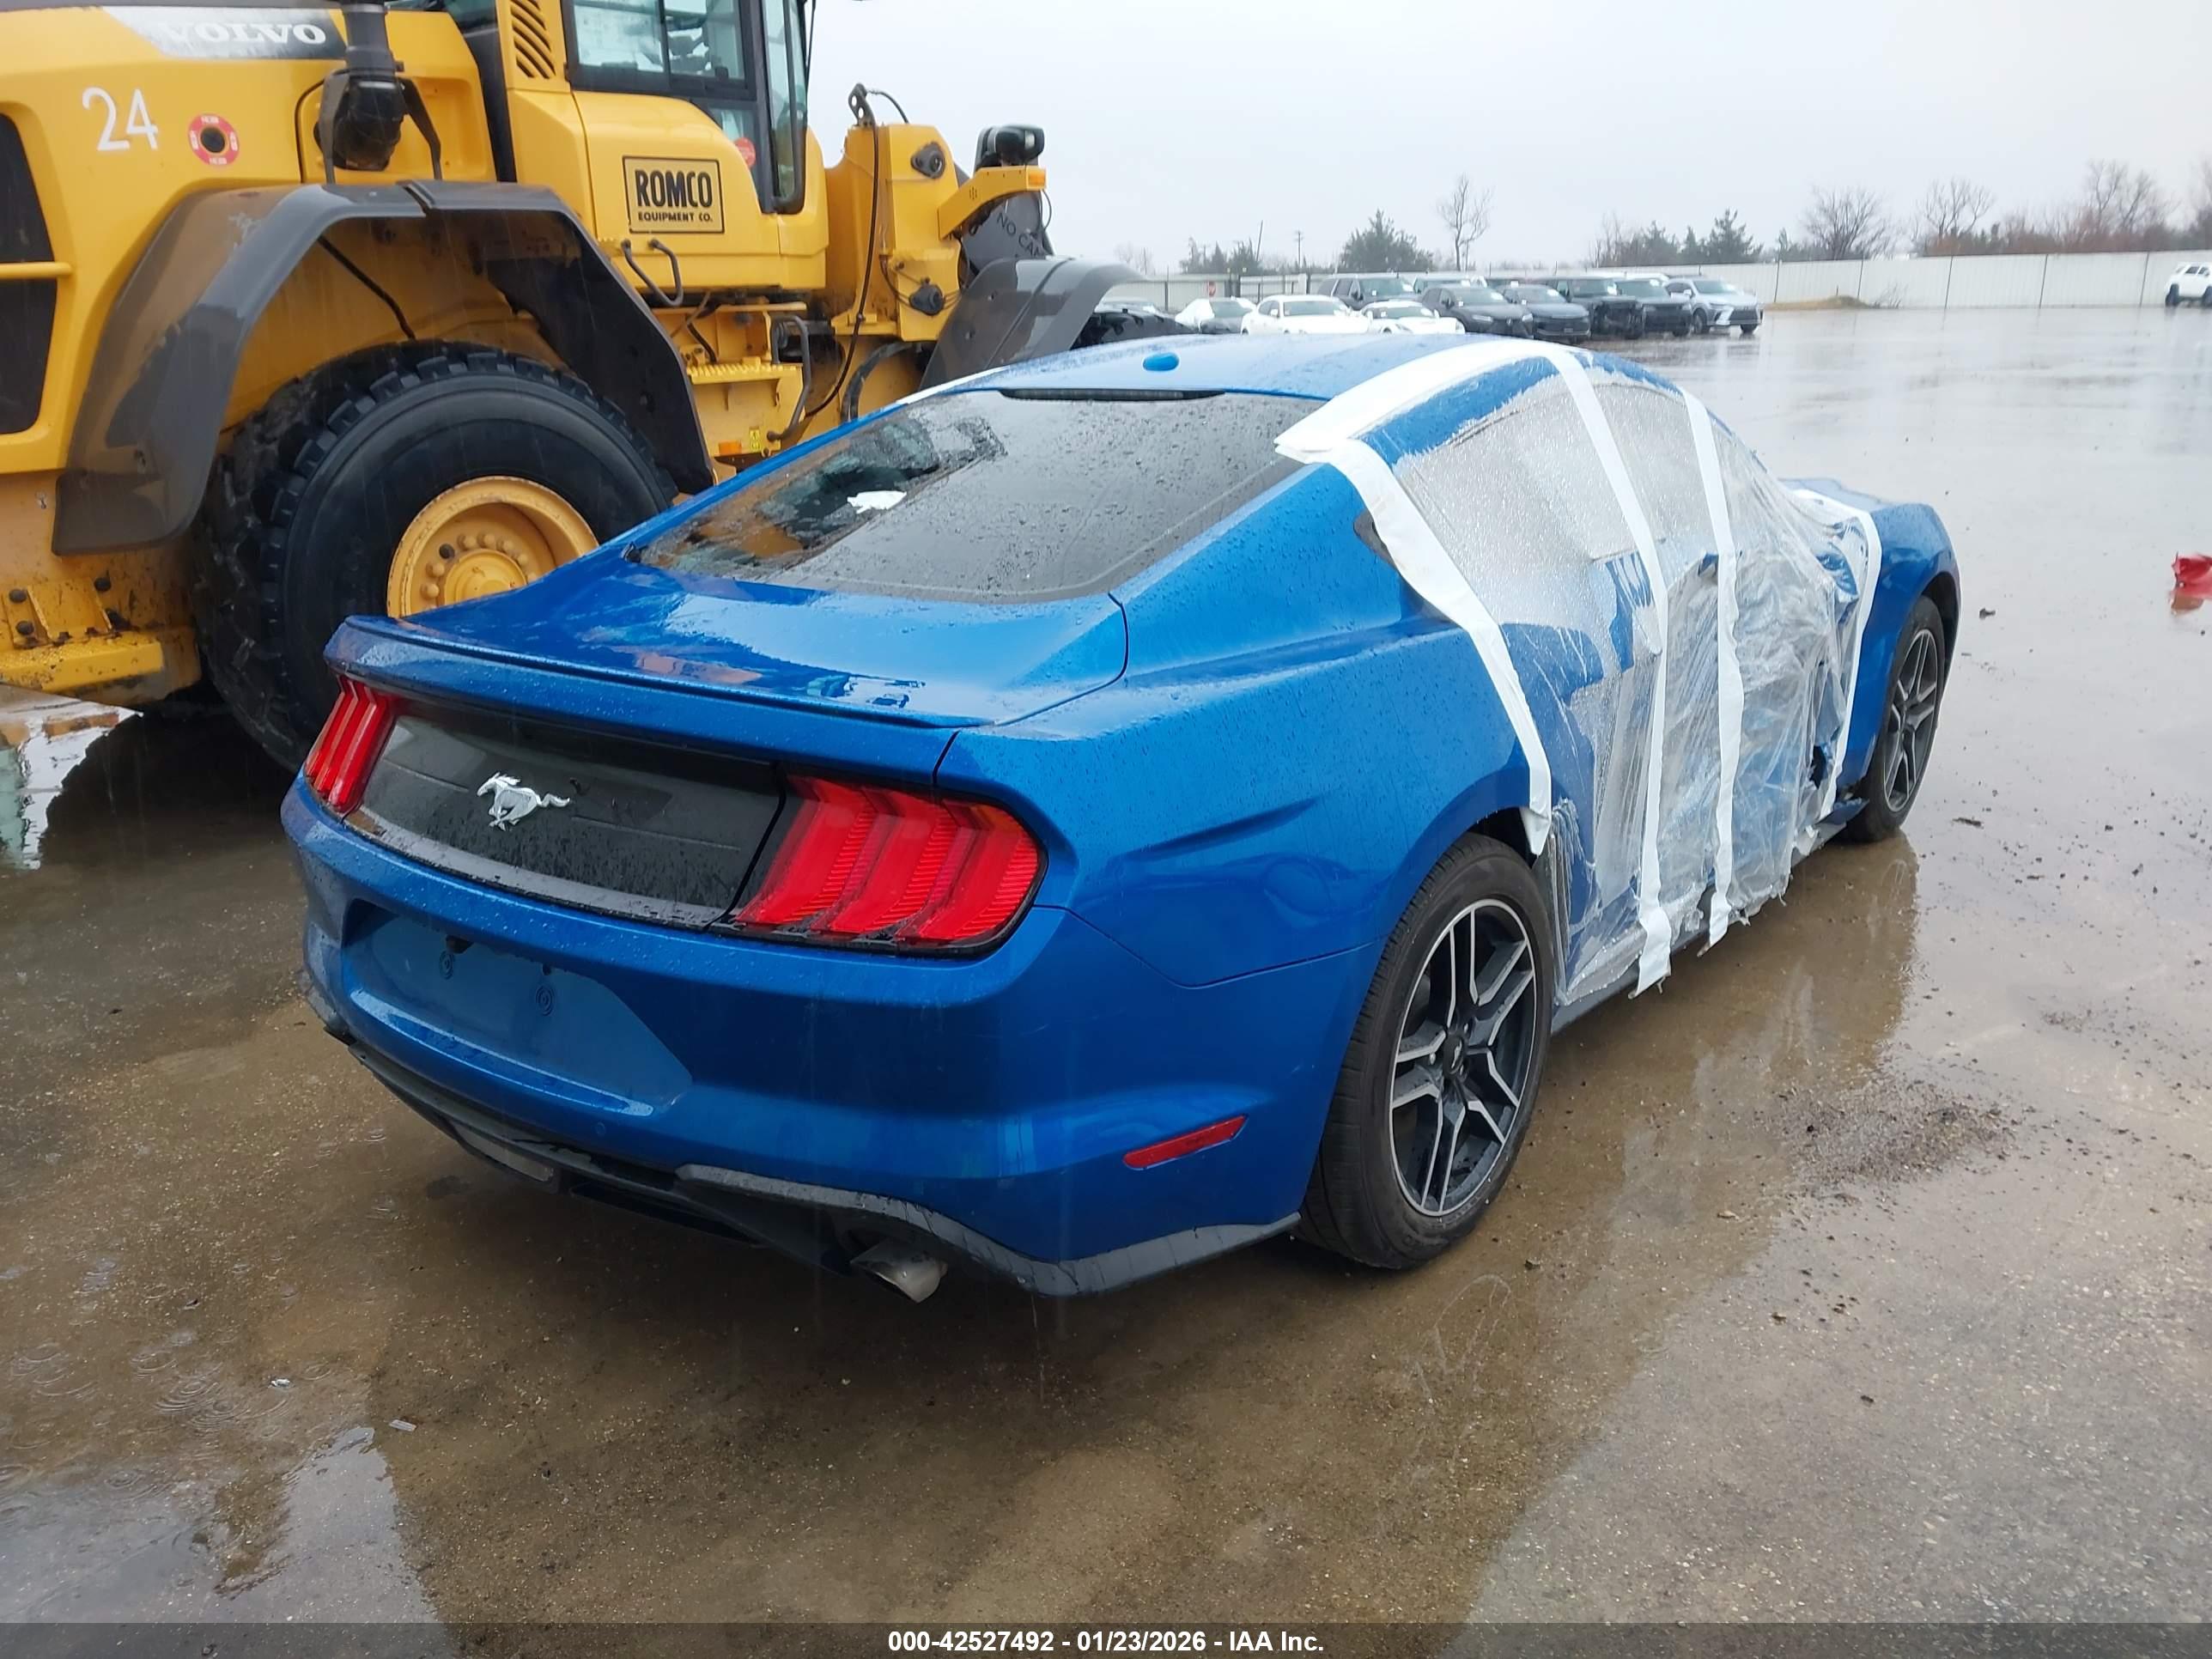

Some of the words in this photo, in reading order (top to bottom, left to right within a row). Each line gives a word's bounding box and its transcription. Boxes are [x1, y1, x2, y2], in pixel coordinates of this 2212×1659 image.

[161, 22, 326, 44] VOLVO
[82, 87, 159, 151] 24
[635, 169, 713, 208] ROMCO
[638, 211, 695, 222] EQUIPMENT
[698, 213, 714, 222] CO.
[996, 212, 1017, 236] NO
